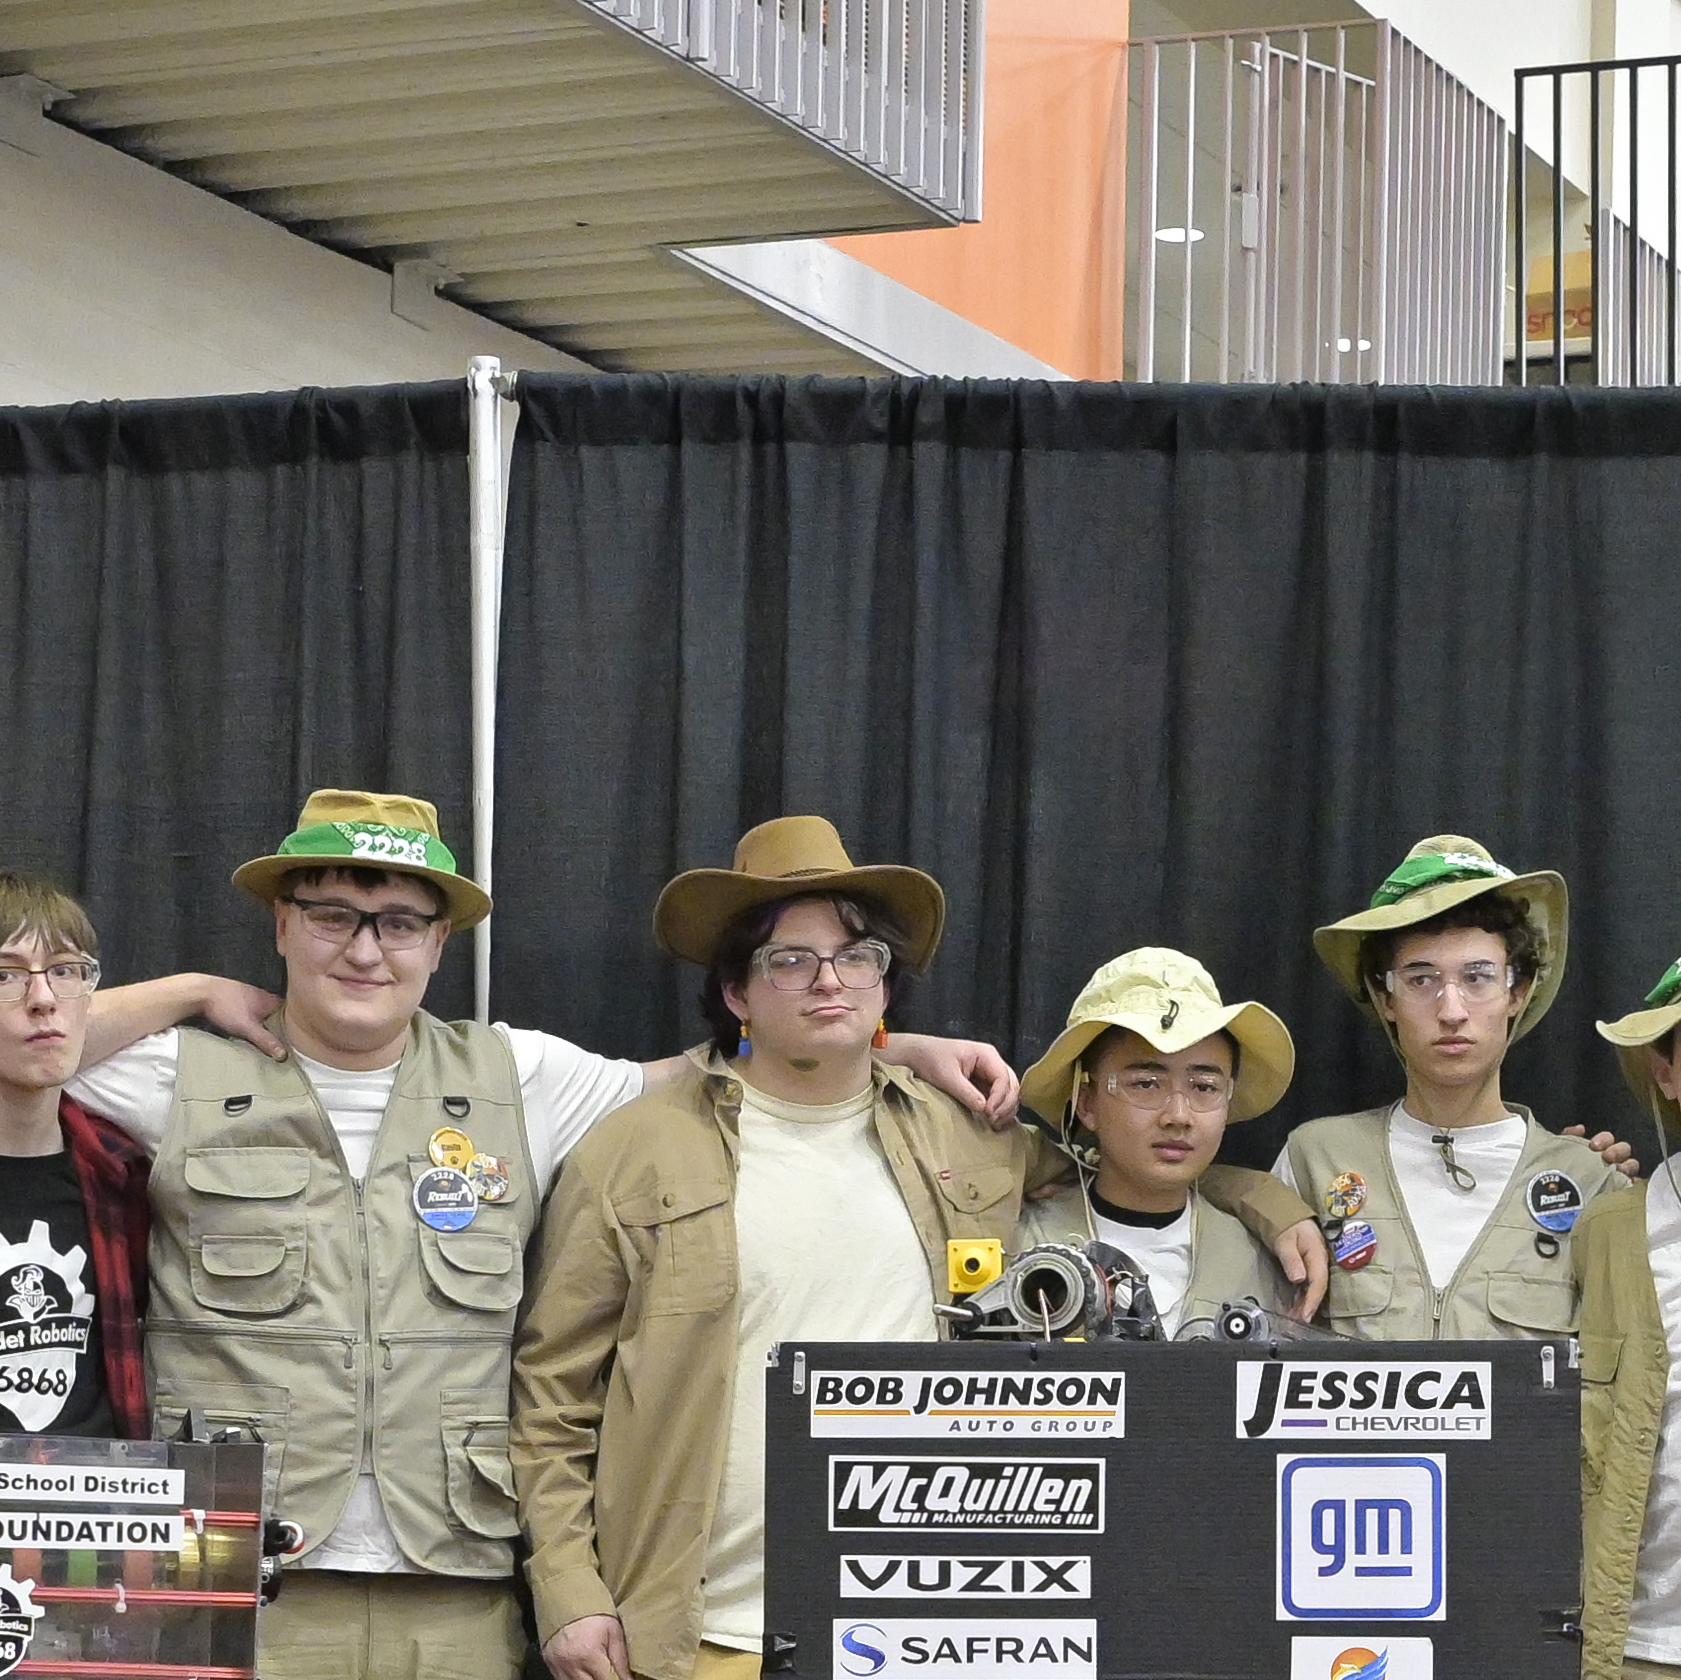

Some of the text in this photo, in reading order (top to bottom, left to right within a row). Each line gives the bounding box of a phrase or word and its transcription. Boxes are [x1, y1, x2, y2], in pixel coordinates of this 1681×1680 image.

[352, 832, 428, 867] 2228
[30, 1321, 86, 1345] Robotics
[816, 1376, 1122, 1415] BOB JOHNSON
[1243, 1363, 1486, 1438] JESSICA
[948, 1420, 1114, 1433] AUTO GROUP
[1335, 1416, 1486, 1431] CHEVROLET
[83, 1475, 170, 1495] District
[837, 1465, 1093, 1523] McQuillen
[931, 1512, 1062, 1525] MANUFACTURING
[1311, 1499, 1412, 1577] gm
[844, 1559, 1082, 1593] VUZIX
[900, 1636, 1093, 1665] SAFRAN
